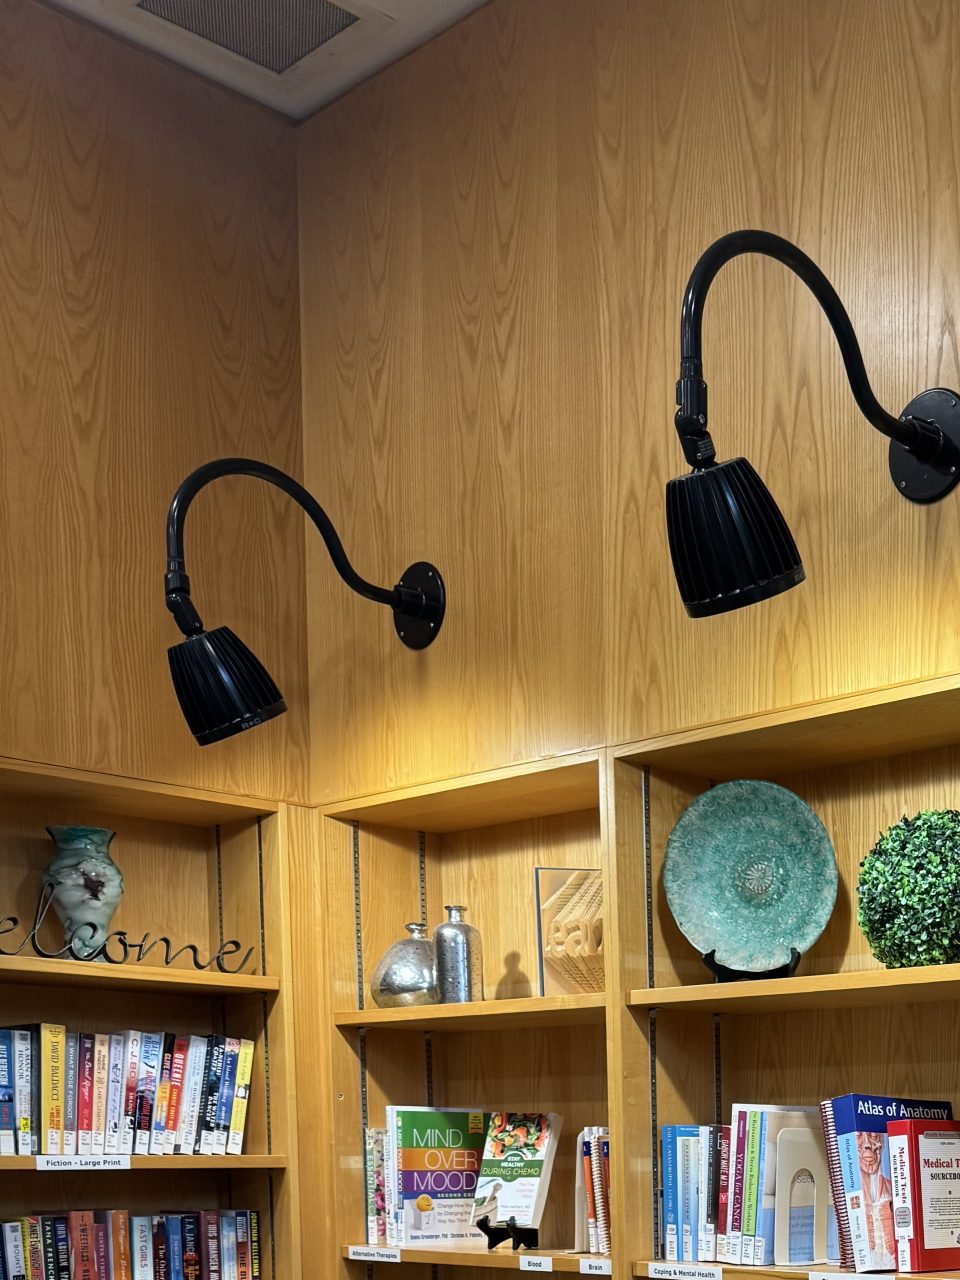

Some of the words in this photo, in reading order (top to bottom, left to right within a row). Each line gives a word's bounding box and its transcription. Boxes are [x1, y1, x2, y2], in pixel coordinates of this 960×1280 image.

[51, 1041, 59, 1064] DAVID
[171, 1053, 184, 1086] QUEENIE
[51, 1065, 59, 1100] BALDACCI
[858, 1101, 884, 1115] Atlas
[886, 1103, 897, 1116] of
[899, 1104, 948, 1120] Anatomy
[413, 1128, 463, 1148] MIND
[80, 1160, 101, 1168] Large
[425, 1150, 478, 1169] OVER
[923, 1158, 953, 1168] Medical
[413, 1171, 477, 1191] MOOD
[47, 1248, 55, 1280] FRENCH
[352, 1250, 376, 1259] Alternative
[377, 1251, 397, 1260] Therapies
[653, 1268, 672, 1277] Coping
